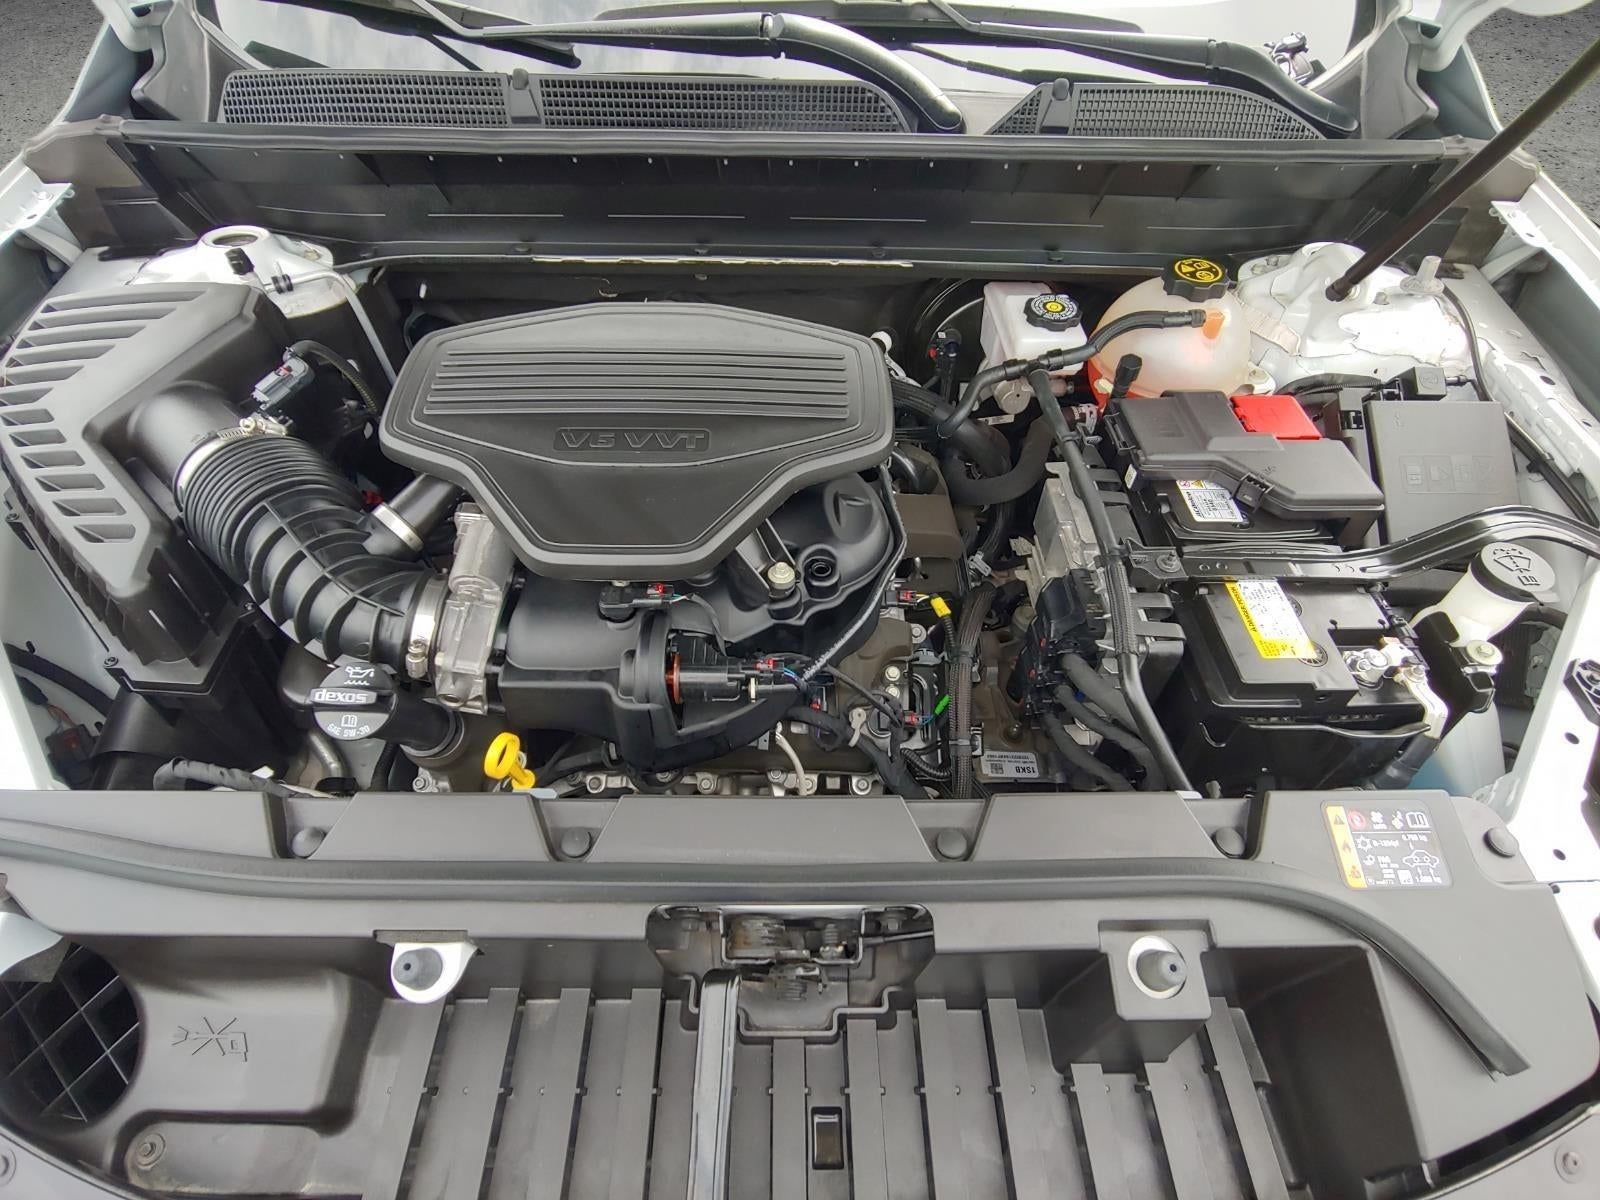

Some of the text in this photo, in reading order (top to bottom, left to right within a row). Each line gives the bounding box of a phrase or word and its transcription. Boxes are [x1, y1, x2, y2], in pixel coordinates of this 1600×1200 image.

[561, 432, 705, 449] V6 VVT
[314, 689, 368, 703] dexos
[327, 723, 371, 737] SAE 5W-30
